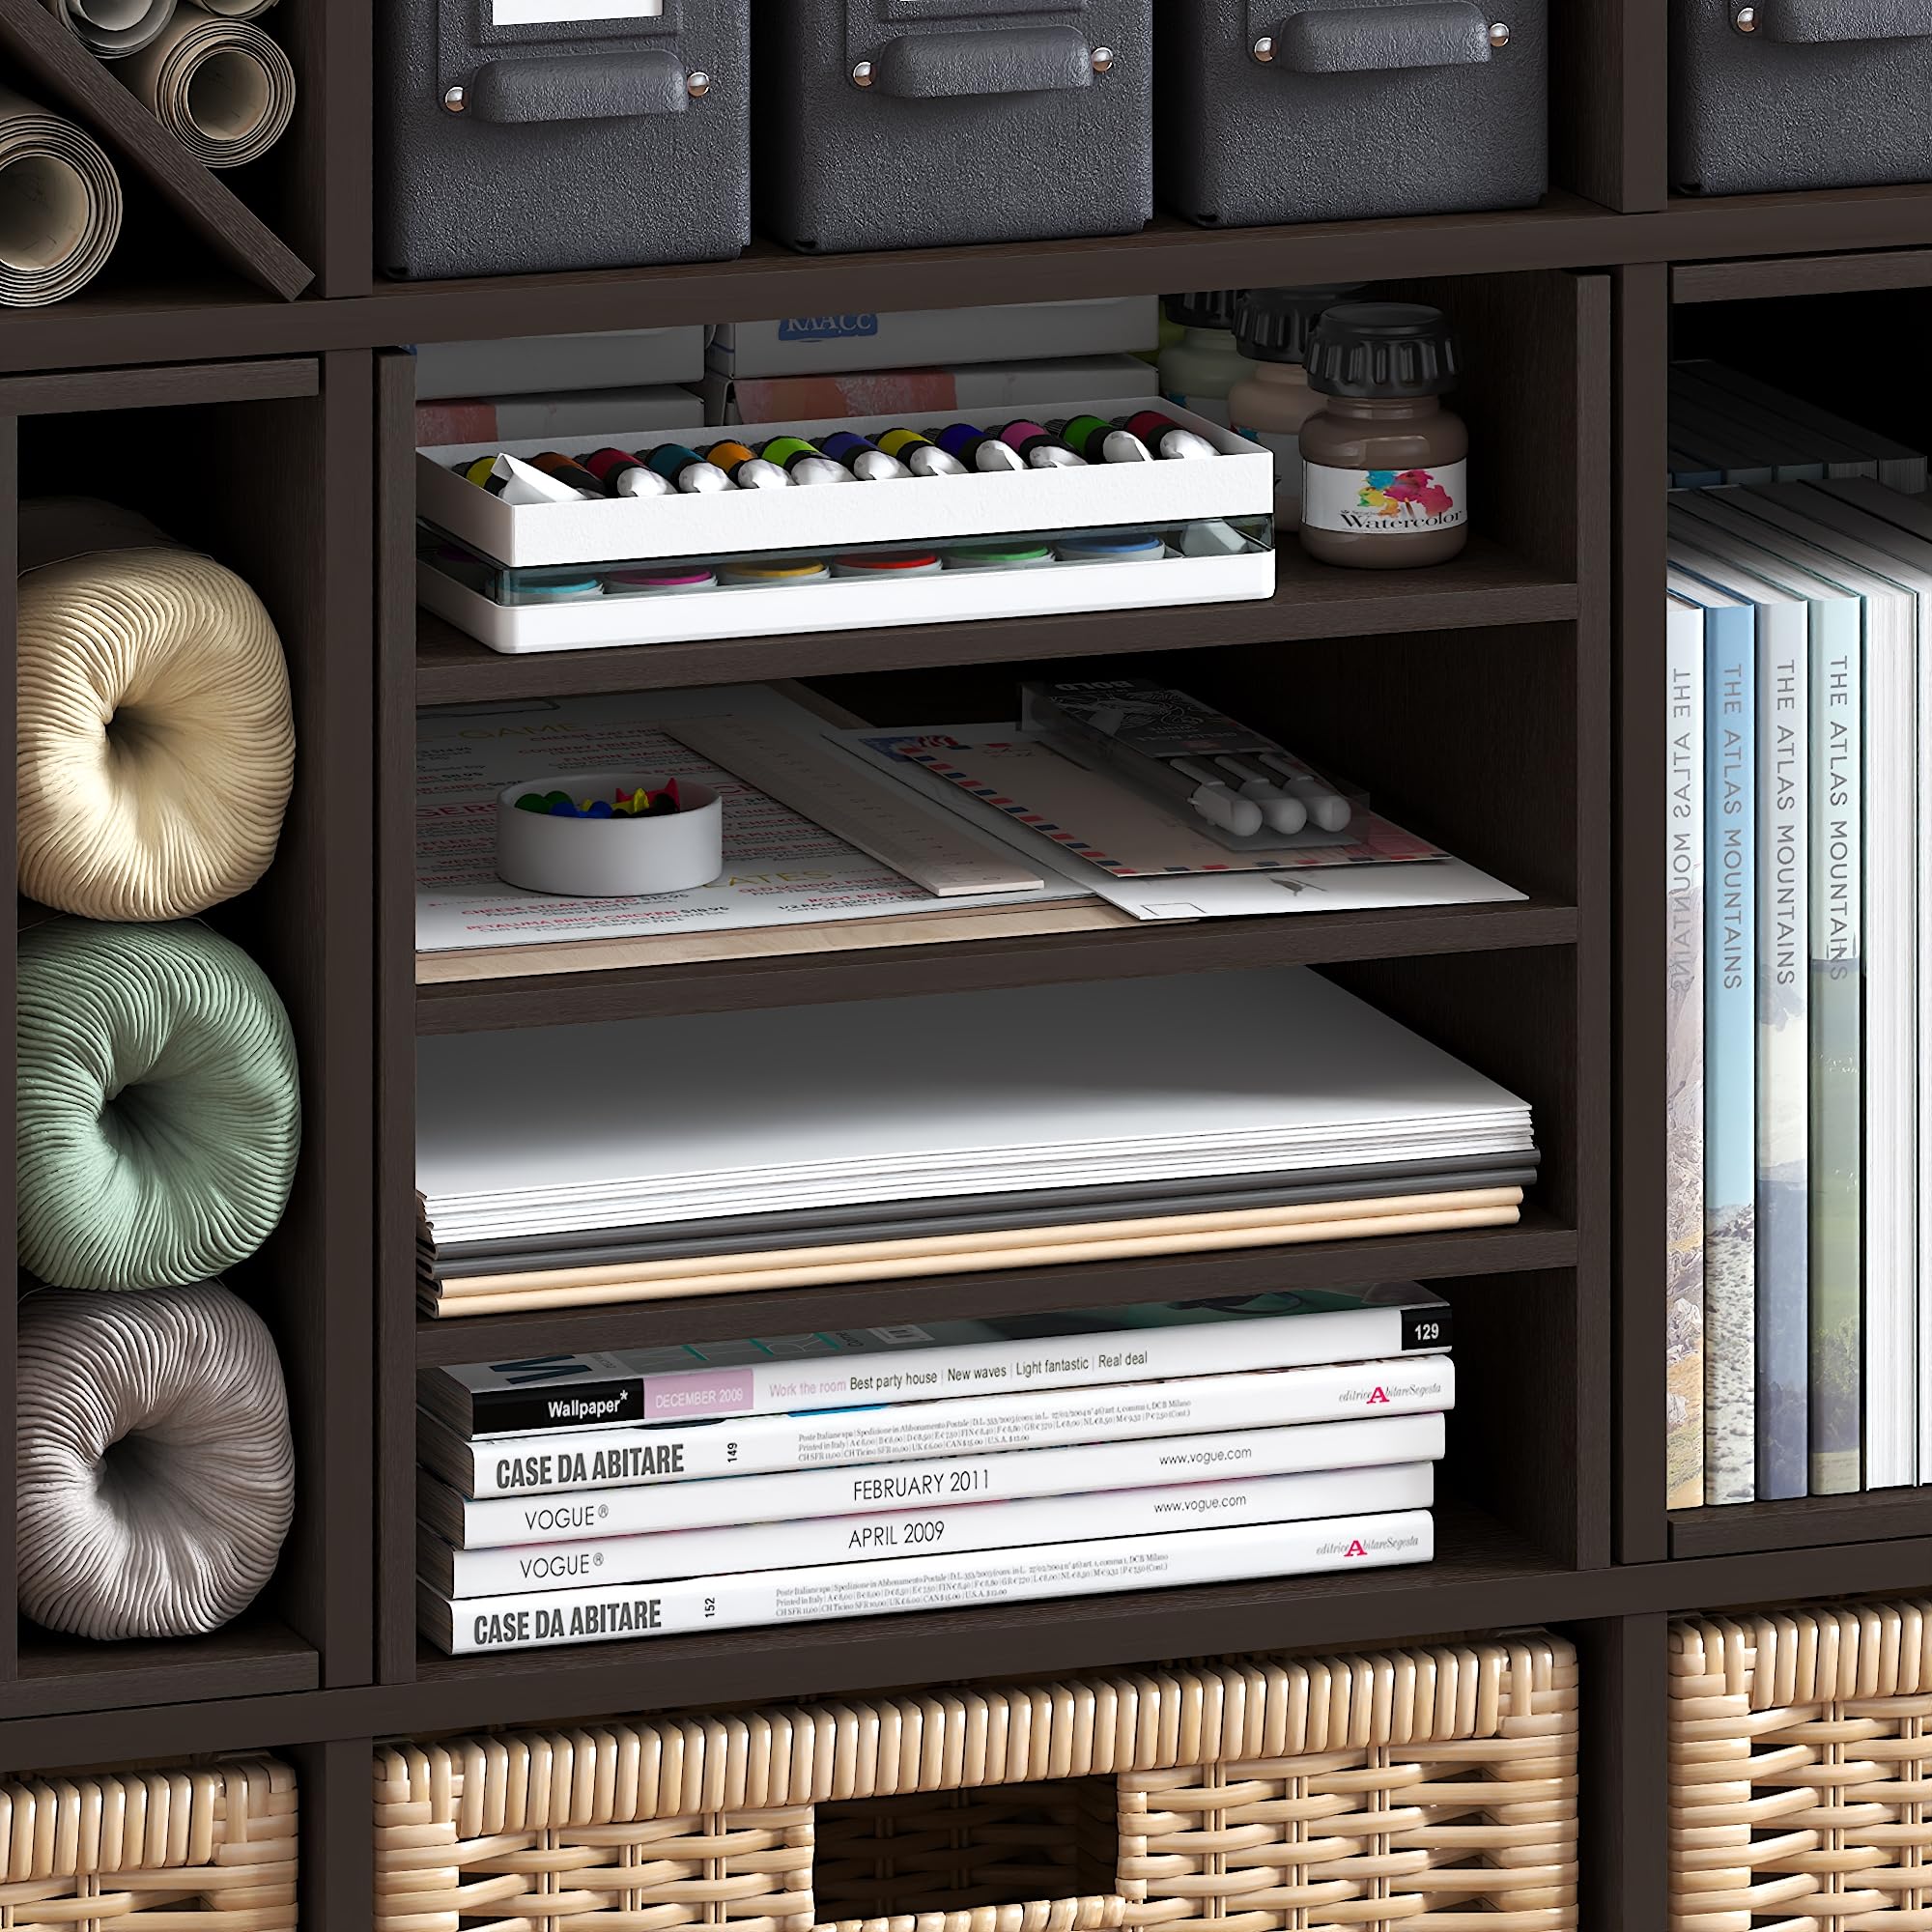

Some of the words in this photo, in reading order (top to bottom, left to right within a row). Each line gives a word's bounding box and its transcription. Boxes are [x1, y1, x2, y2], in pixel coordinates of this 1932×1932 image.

[1340, 511, 1463, 529] Watercolor
[1724, 664, 1742, 715] THE
[1777, 659, 1794, 710] THE
[1830, 655, 1847, 706] THE
[1724, 727, 1742, 814] ATLAS
[1777, 724, 1794, 810] ATLAS
[1830, 721, 1847, 807] ATLAS
[1724, 829, 1742, 990] MOUNTAINS
[1777, 825, 1794, 985] MOUNTAINS
[1830, 820, 1847, 980] MOUNTAINS
[655, 1392, 716, 1409] DECEMBER
[719, 1389, 743, 1405] 2009
[769, 1381, 797, 1397] Work
[799, 1379, 815, 1394] the
[819, 1380, 846, 1393] room
[850, 1376, 873, 1389] Best
[876, 1375, 902, 1390] party
[905, 1370, 937, 1385] house
[948, 1367, 971, 1381] New
[974, 1367, 1007, 1378] waves
[1016, 1360, 1041, 1378] Light
[1044, 1356, 1089, 1373] fantastic
[1098, 1354, 1122, 1368] Real
[1124, 1351, 1147, 1365] deal
[1414, 1322, 1439, 1342] 129
[496, 1455, 553, 1490] CASE
[557, 1452, 586, 1484] DA
[592, 1444, 685, 1481] ABITARE
[726, 1441, 737, 1463] 149
[853, 1474, 944, 1501] FEBRUARY
[950, 1469, 989, 1493] 2011
[1159, 1447, 1252, 1466] www.vogue.com
[848, 1523, 897, 1549] APRIL
[903, 1520, 945, 1545] 2009
[1153, 1493, 1247, 1515] www.vogue.com
[473, 1611, 530, 1645] CASE
[535, 1607, 564, 1639] DA
[570, 1599, 662, 1635] ABITARE
[704, 1598, 716, 1619] 152
